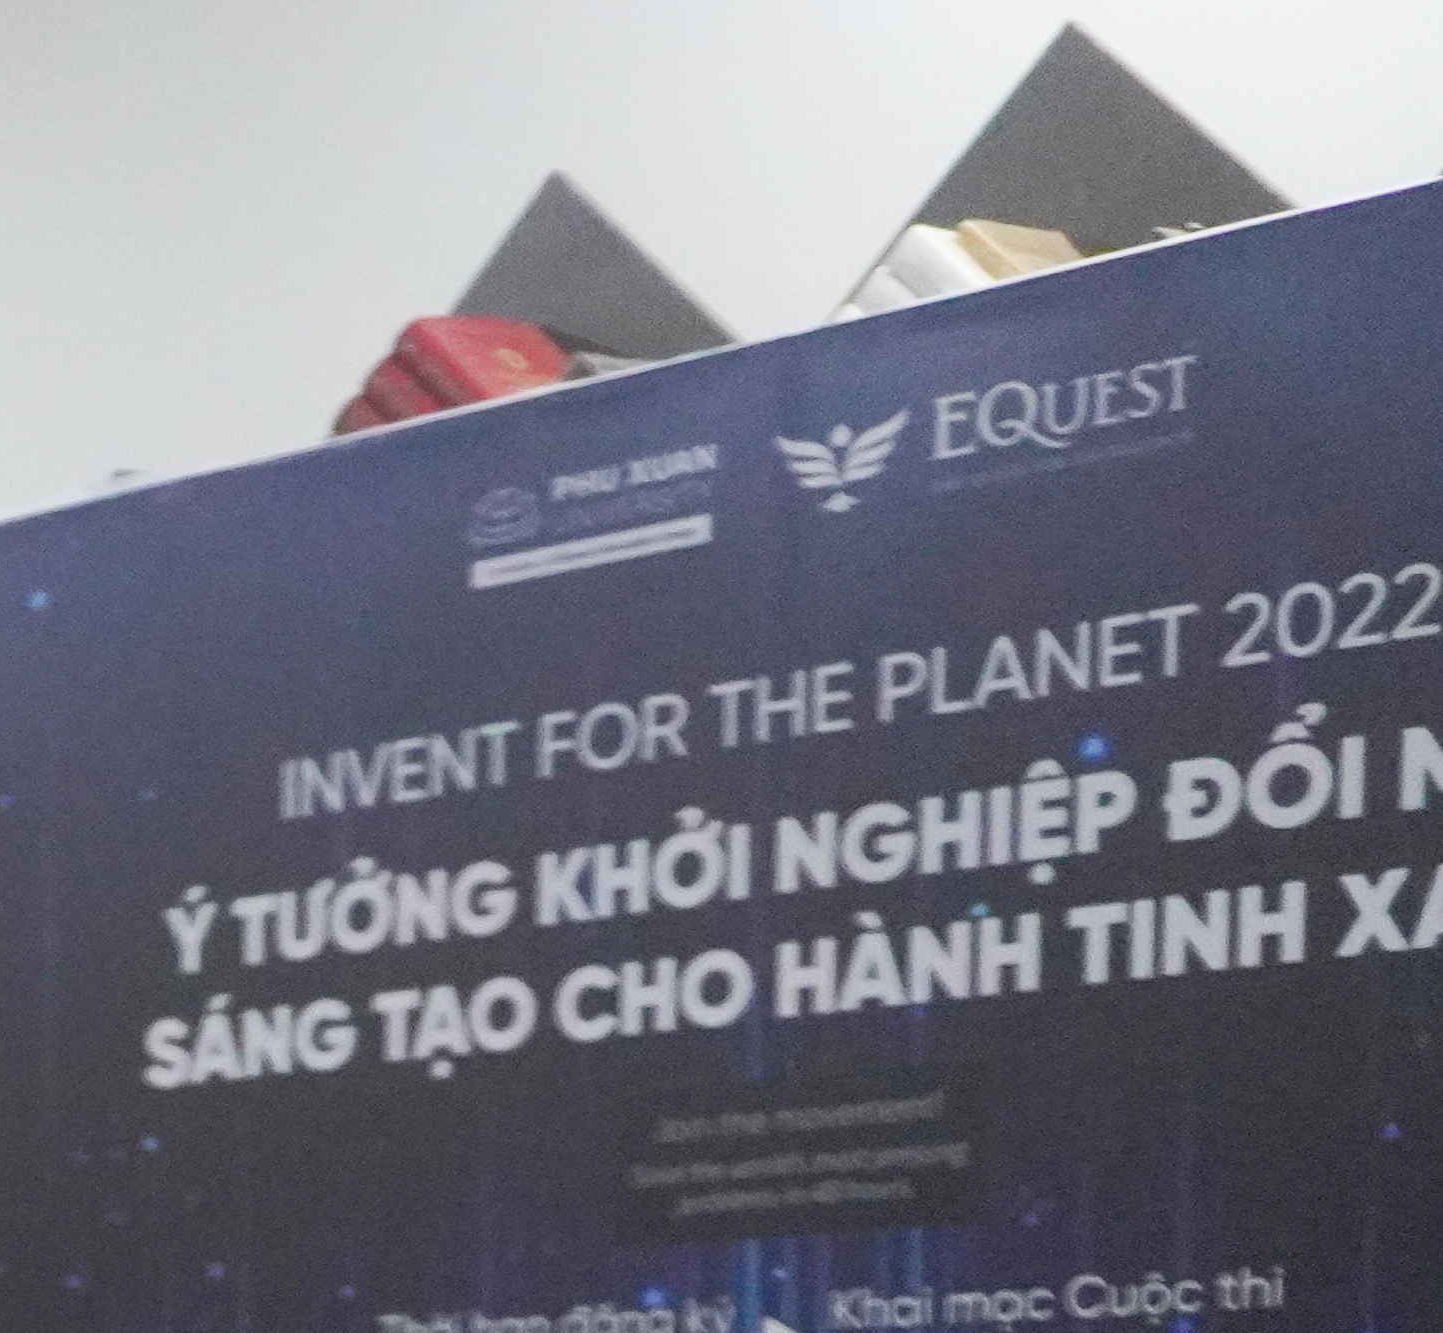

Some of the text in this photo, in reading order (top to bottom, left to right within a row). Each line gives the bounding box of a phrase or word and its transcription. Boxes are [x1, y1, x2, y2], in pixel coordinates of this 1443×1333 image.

[279, 561, 1442, 820] INVENT FOR THE PLANET 2022
[165, 884, 217, 973] Ý
[232, 855, 517, 967] TƯỞNG
[535, 806, 753, 930] KHỞI
[773, 759, 1135, 885] NGHIỆP
[1166, 702, 1366, 841] ĐỔI
[143, 995, 358, 1089] SÁNG
[373, 977, 537, 1078] TẠO
[553, 950, 754, 1042] CHO
[773, 911, 1042, 1018] HÀNH
[1070, 881, 1307, 986] TINH
[831, 1265, 1285, 1333] Khai mạc Cuộc thi
